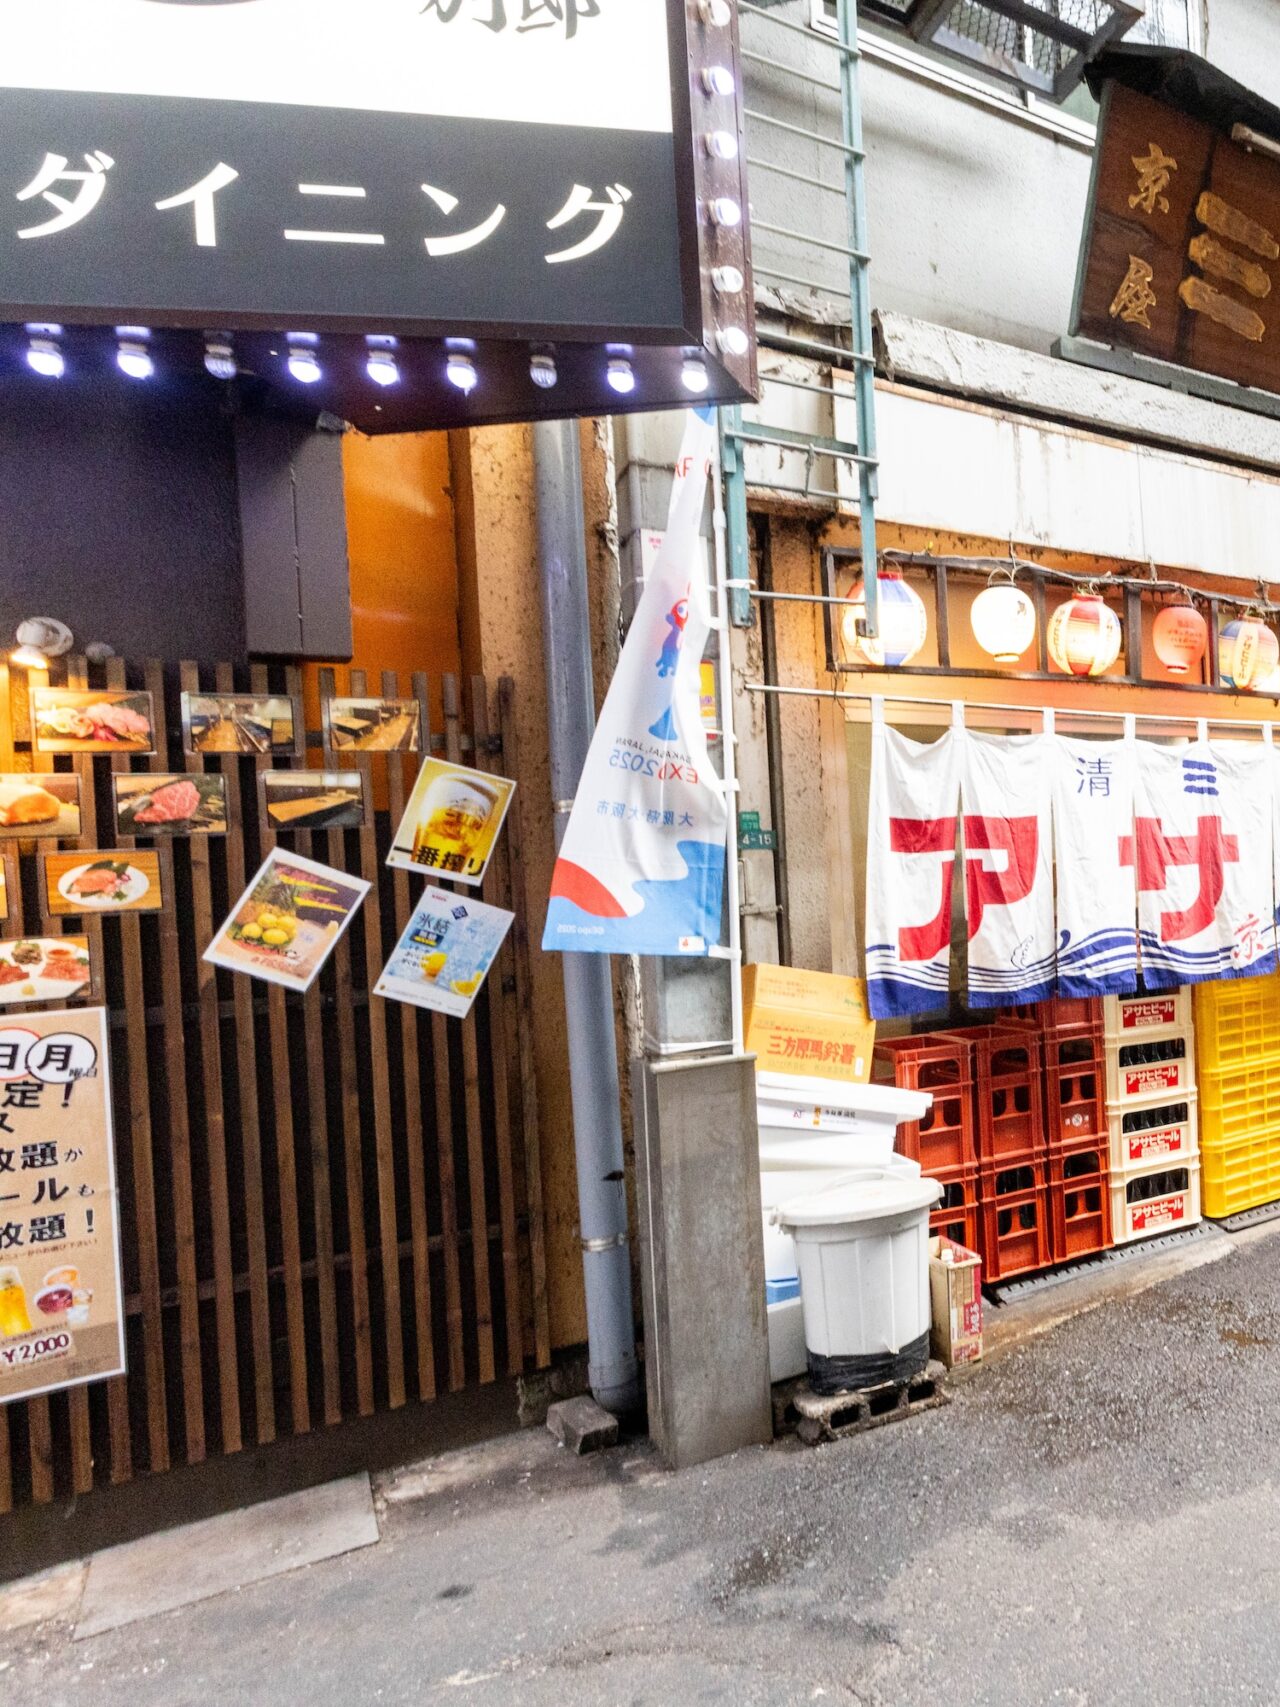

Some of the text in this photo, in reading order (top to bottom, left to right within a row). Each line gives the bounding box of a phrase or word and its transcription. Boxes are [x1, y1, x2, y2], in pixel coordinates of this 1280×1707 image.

[16, 149, 633, 264] ダイニング
[1074, 757, 1113, 797] 清
[1123, 1001, 1174, 1018] アサヒビール
[36, 1044, 73, 1072] 月
[1126, 1066, 1177, 1086] アサヒビール
[1130, 1130, 1180, 1151] アサヒビール
[1132, 1196, 1183, 1221] アサヒビール
